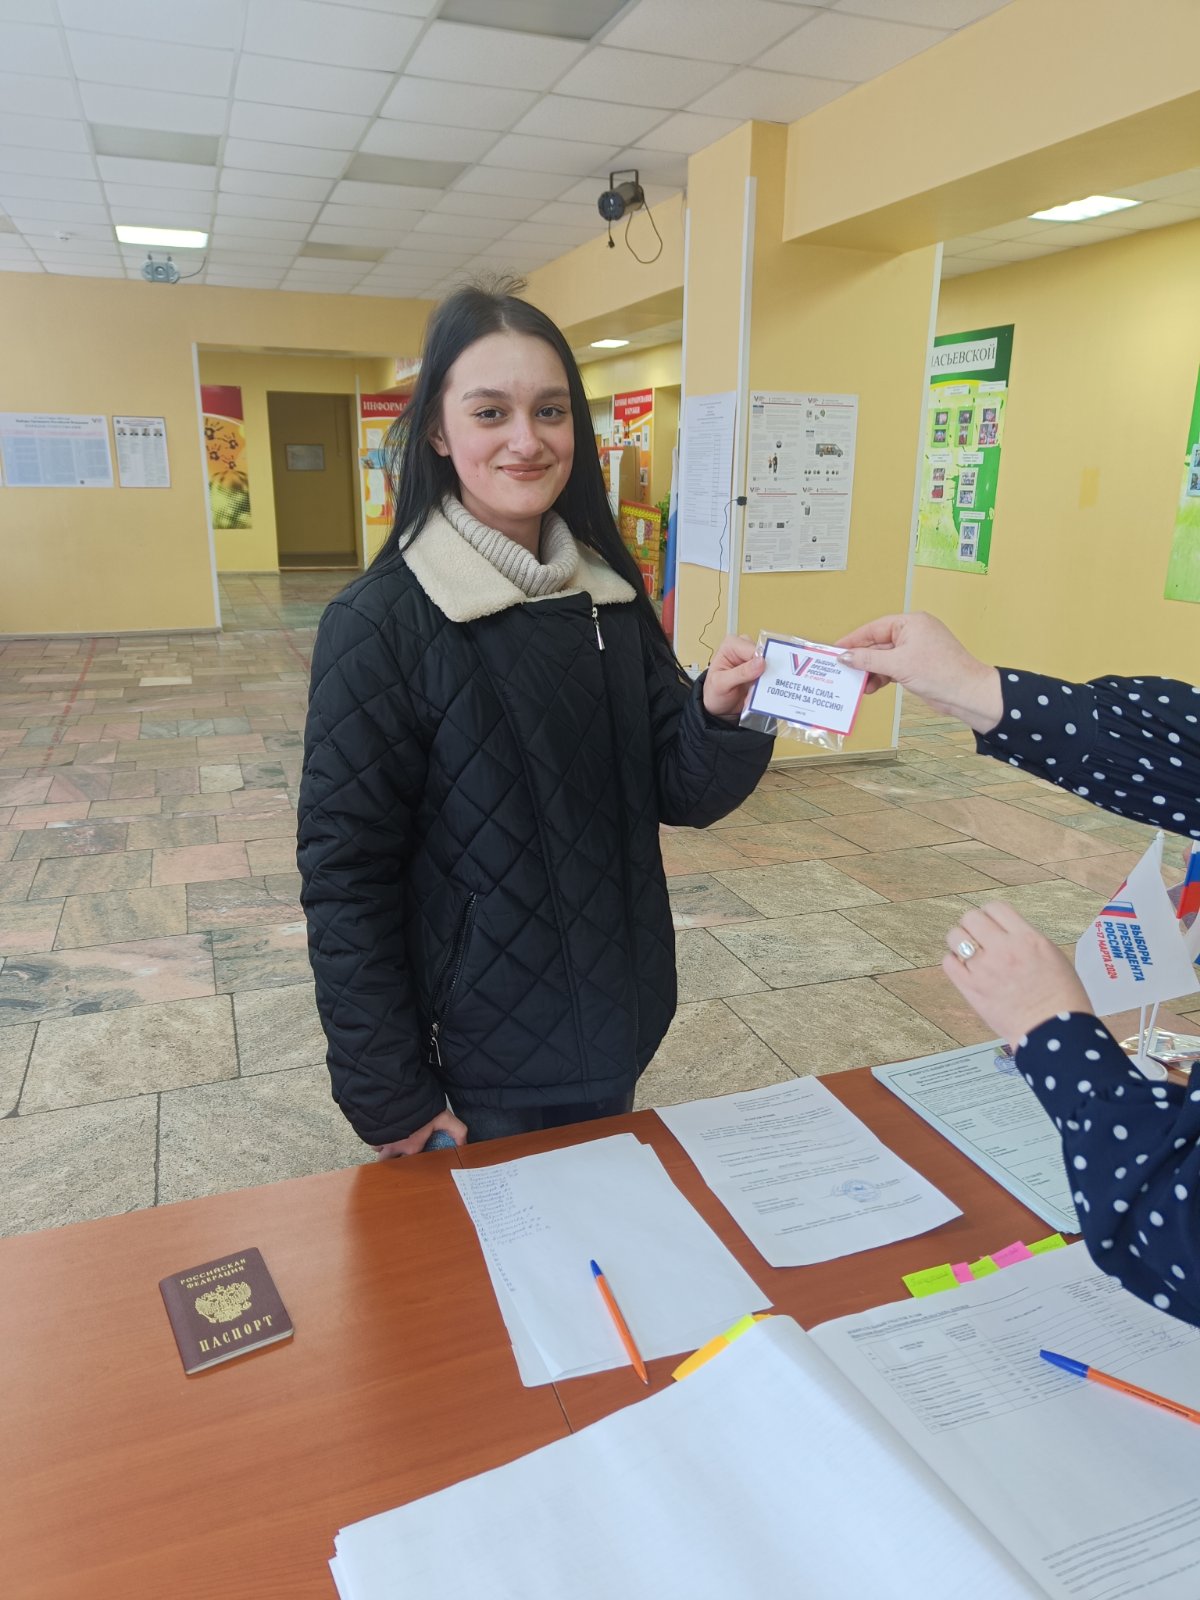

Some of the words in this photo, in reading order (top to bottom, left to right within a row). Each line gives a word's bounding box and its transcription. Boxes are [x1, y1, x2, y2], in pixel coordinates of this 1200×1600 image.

[931, 343, 995, 367] АСЬЕВСКОЙ
[814, 658, 837, 668] ВЫБОРЫ
[767, 686, 801, 701] ГОЛОСУЕМ
[812, 698, 844, 712] РОССИЮ!
[775, 679, 802, 692] ВМЕСТЕ
[802, 685, 815, 695] МЫ
[815, 689, 834, 699] СИЛА
[1103, 921, 1124, 959] РОССИИ
[1116, 922, 1145, 981] ПРЕЗИДЕНТА
[1129, 924, 1153, 966] ВЫБОРЫ
[1098, 940, 1112, 962] МАРТА
[1105, 963, 1118, 979] 2024
[180, 1258, 246, 1285] РОССИЙСКАЯ
[186, 1266, 245, 1289] ФЕДЕРАЦИЯ
[199, 1315, 273, 1352] ПАСПОРТ
